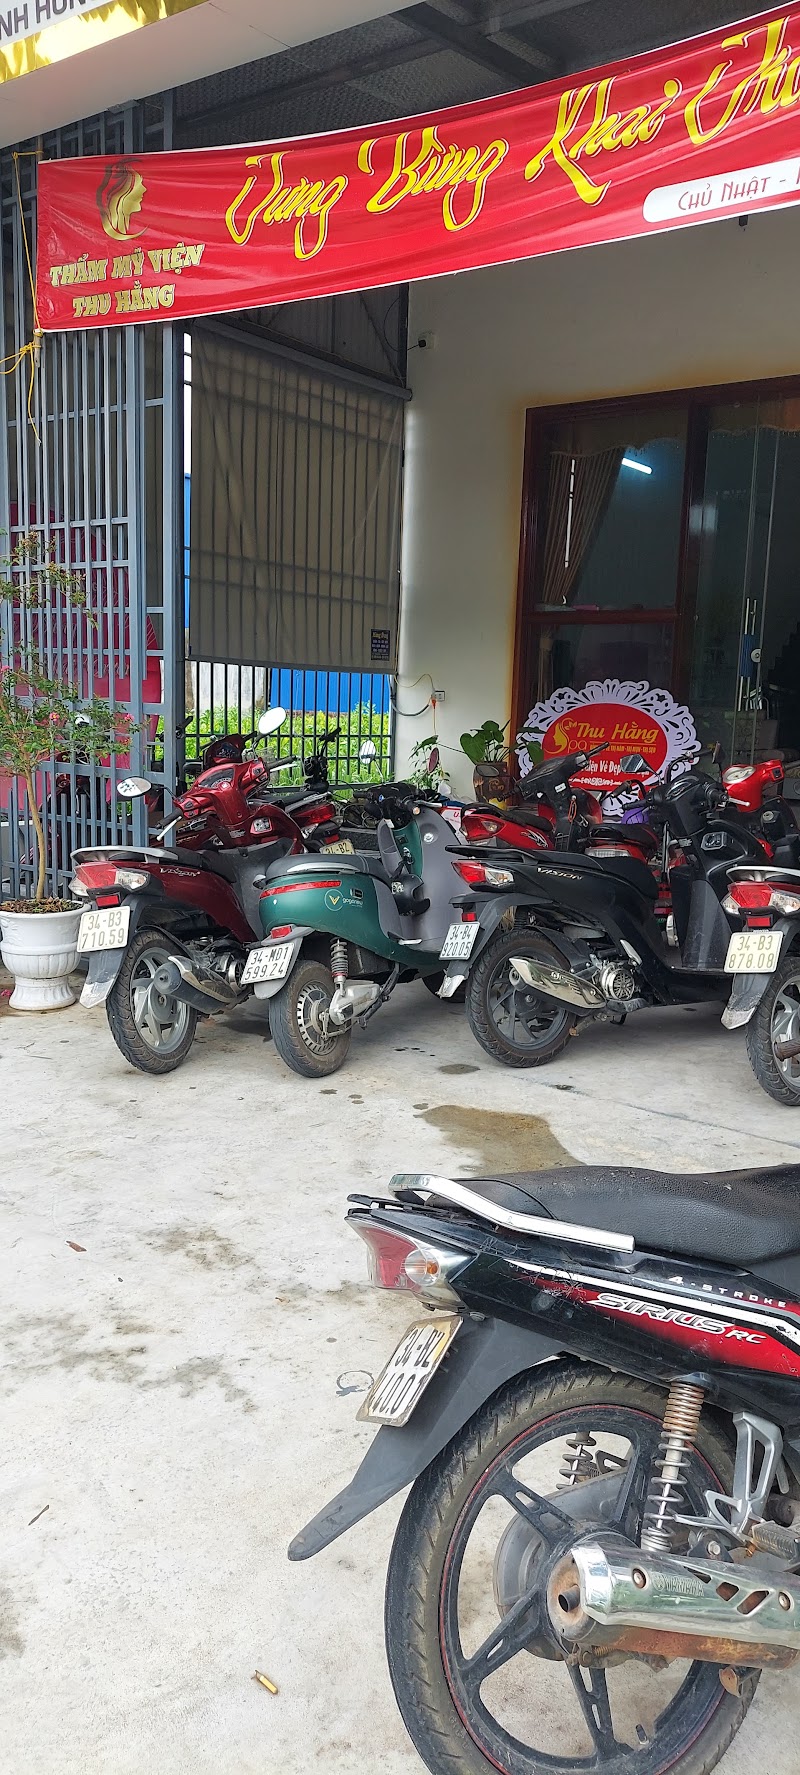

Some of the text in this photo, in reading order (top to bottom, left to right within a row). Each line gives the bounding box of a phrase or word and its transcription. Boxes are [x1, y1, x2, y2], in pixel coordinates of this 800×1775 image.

[225, 150, 348, 260] Tưng
[524, 76, 683, 206] Khai
[678, 183, 712, 211] CHỦ
[721, 176, 771, 203] NHẬT
[147, 241, 206, 274] VIỆN
[73, 292, 111, 317] THU
[577, 721, 660, 744] Thu Hằng
[537, 867, 583, 880] VISION
[87, 910, 122, 931] 34-B3
[81, 927, 125, 949] 710.59
[736, 935, 773, 951] 34-B3
[244, 960, 286, 981] 599.24
[728, 953, 775, 969] 878.08
[586, 1293, 767, 1344] SIRIUS RC
